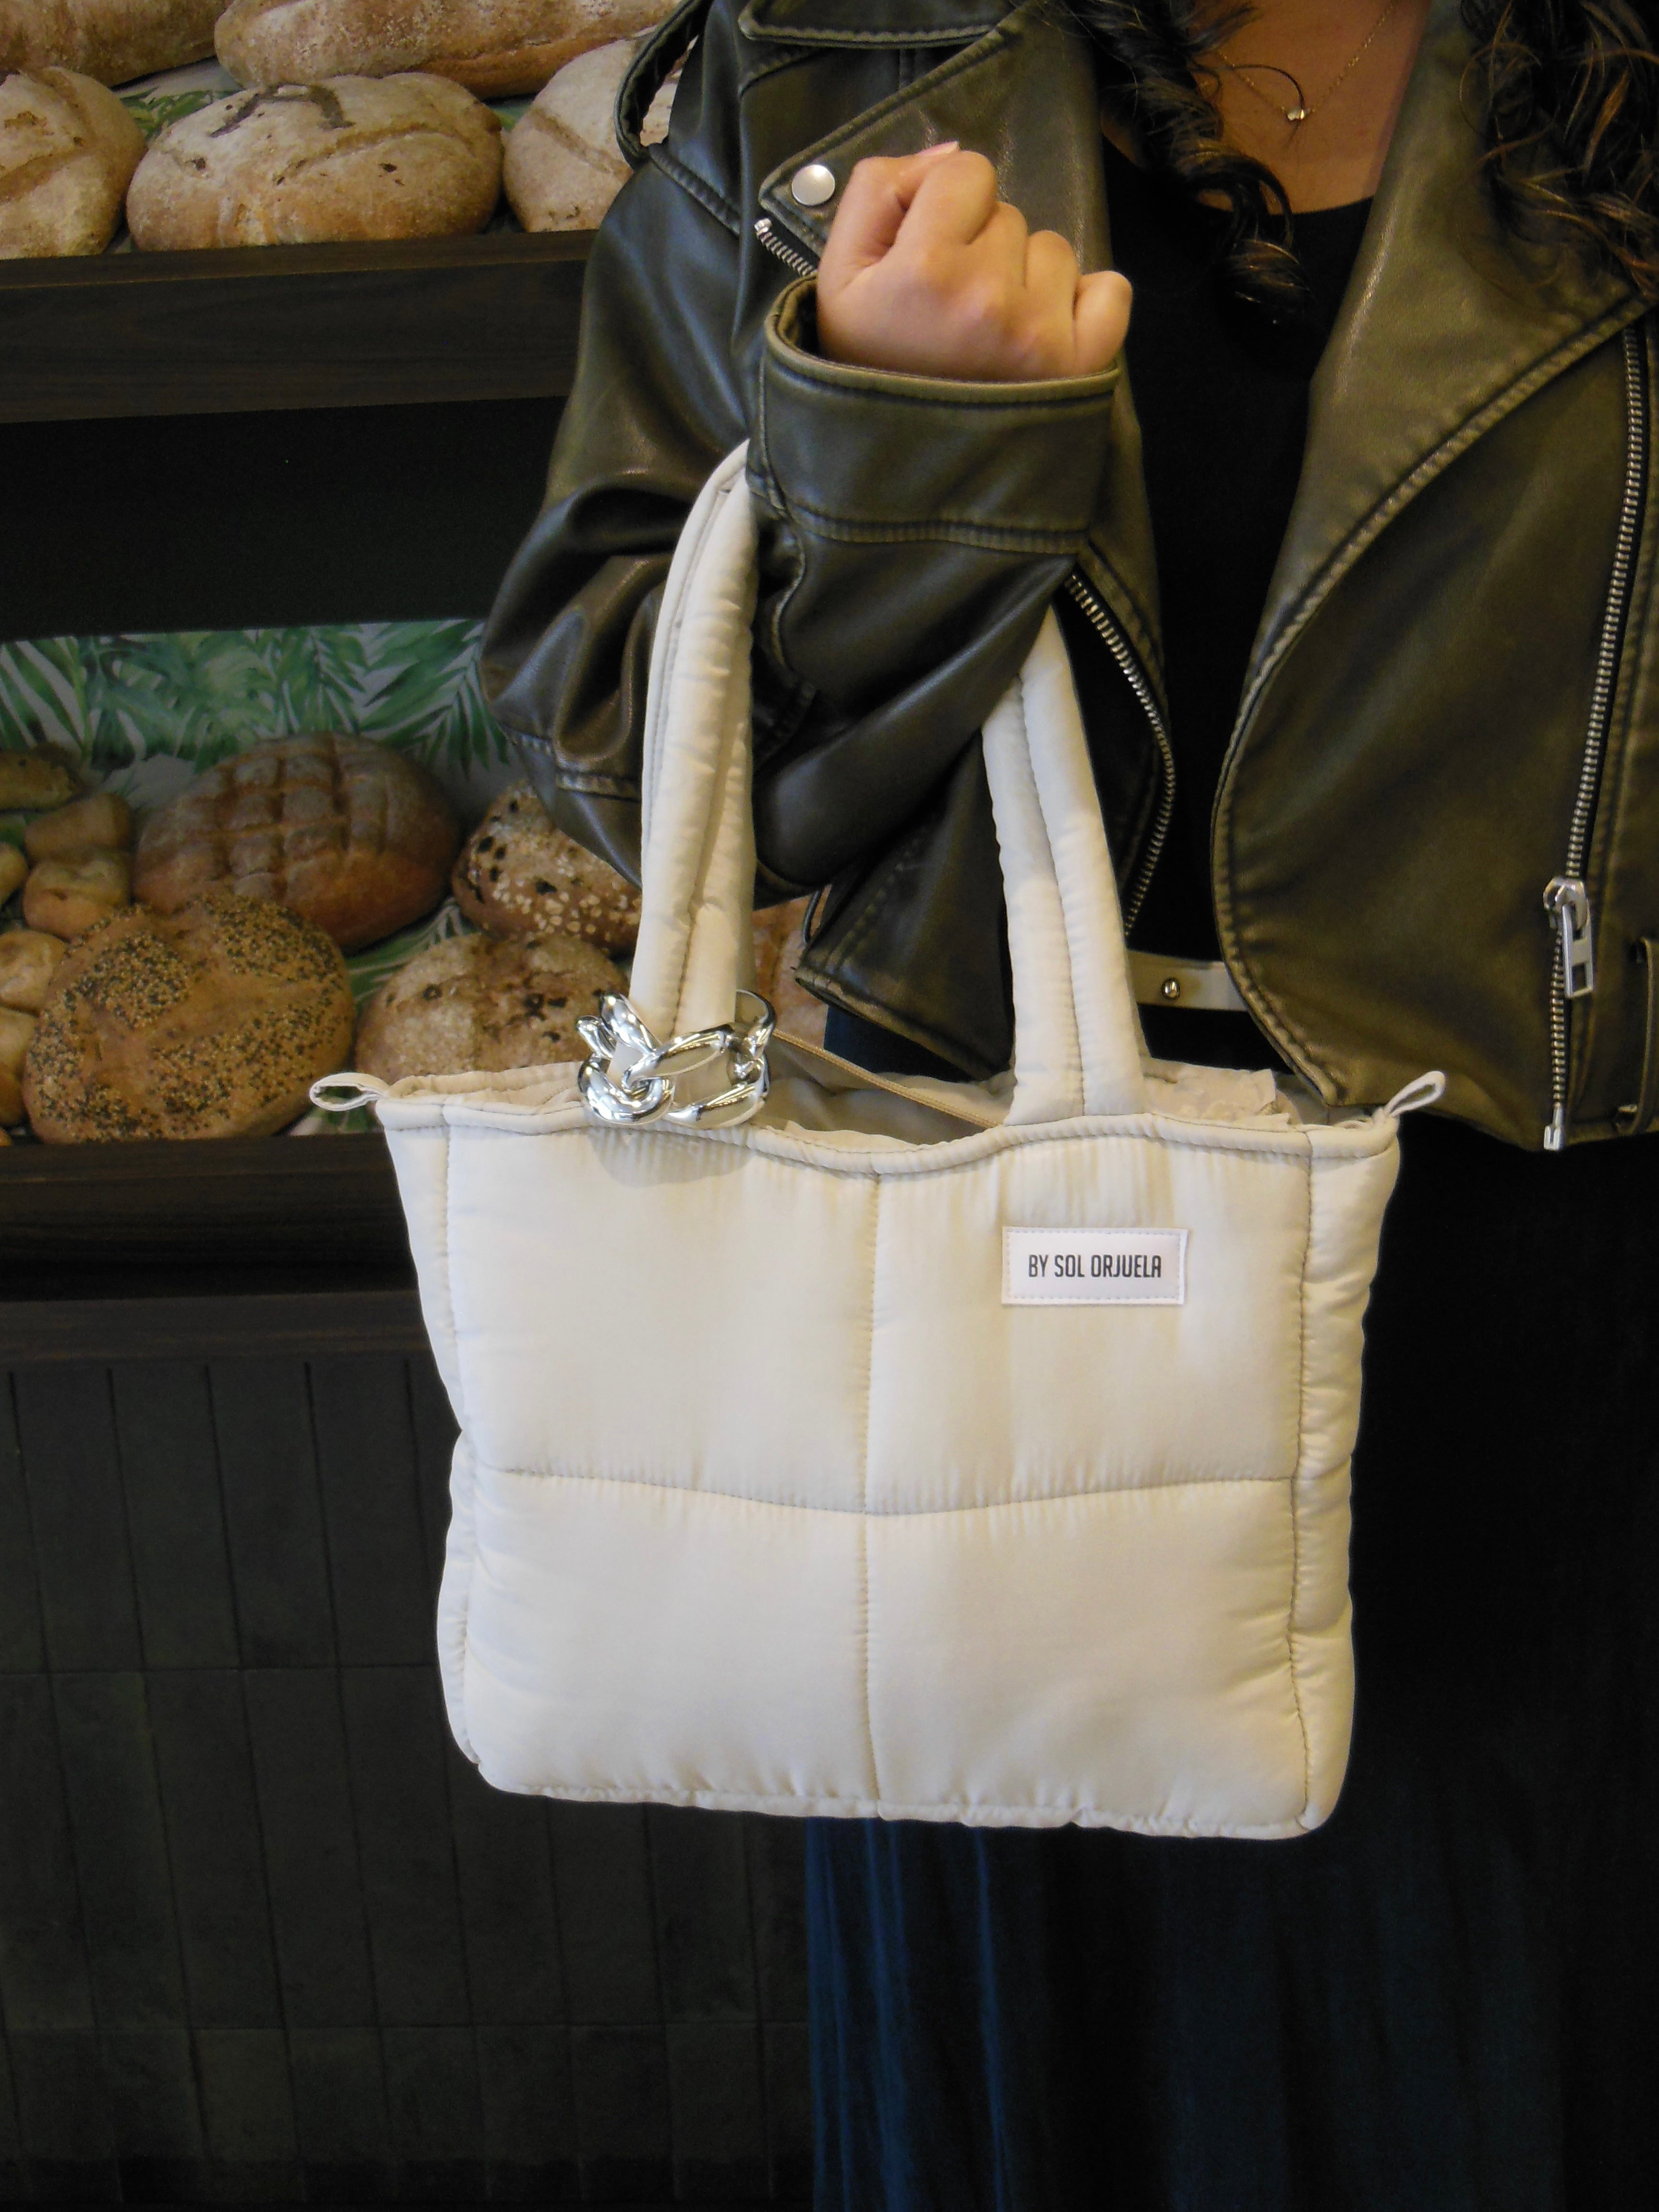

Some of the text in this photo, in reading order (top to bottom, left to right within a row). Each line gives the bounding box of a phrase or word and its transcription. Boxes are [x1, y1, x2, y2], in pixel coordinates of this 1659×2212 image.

[1028, 1254, 1162, 1278] BY SOL ORJUELA
